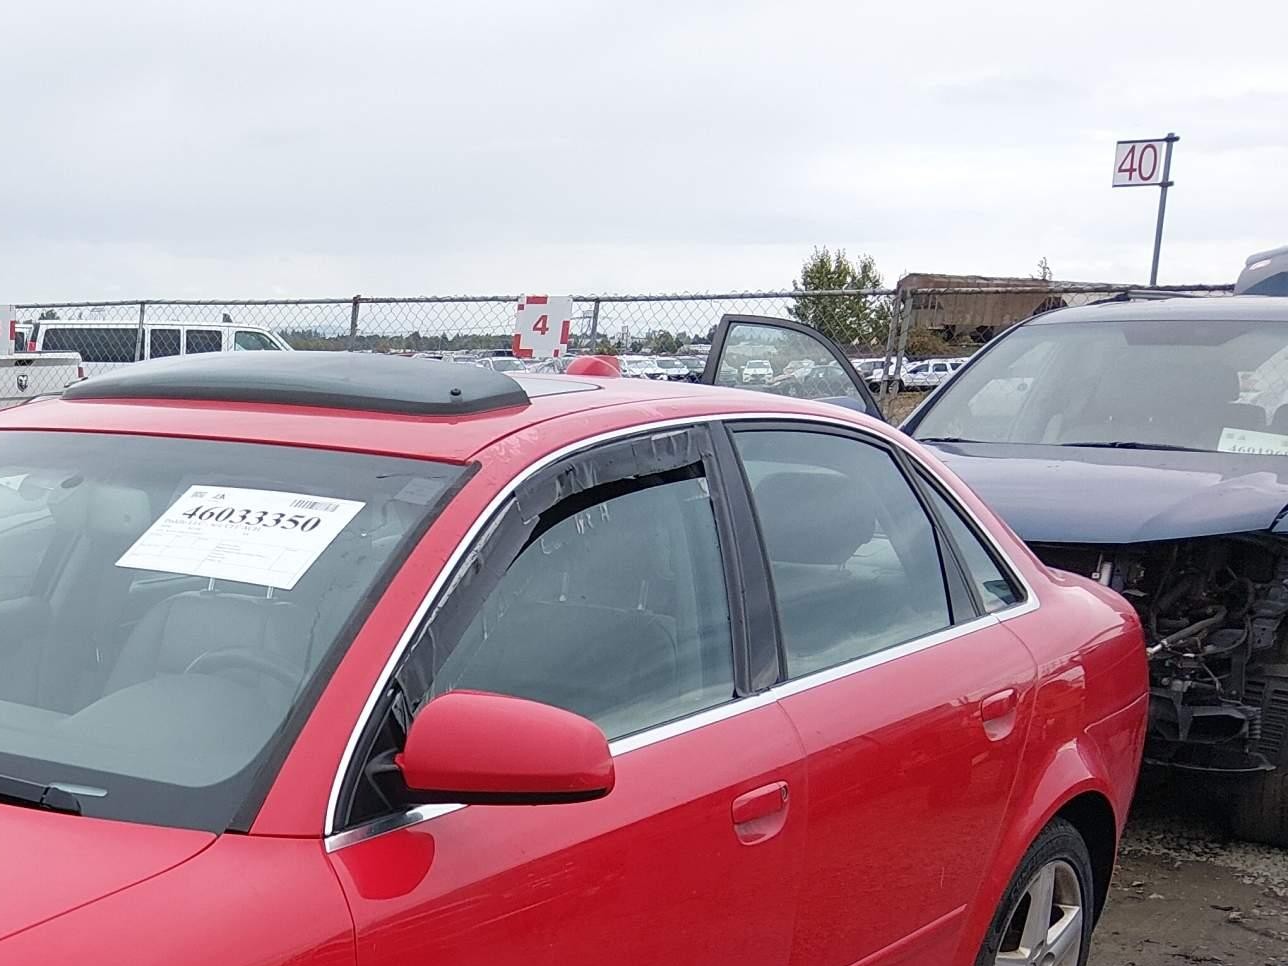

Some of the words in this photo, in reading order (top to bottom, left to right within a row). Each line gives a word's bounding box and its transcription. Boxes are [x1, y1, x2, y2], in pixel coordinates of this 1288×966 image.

[1117, 143, 1158, 181] 40
[532, 314, 549, 335] 4
[182, 505, 322, 533] 46033350
